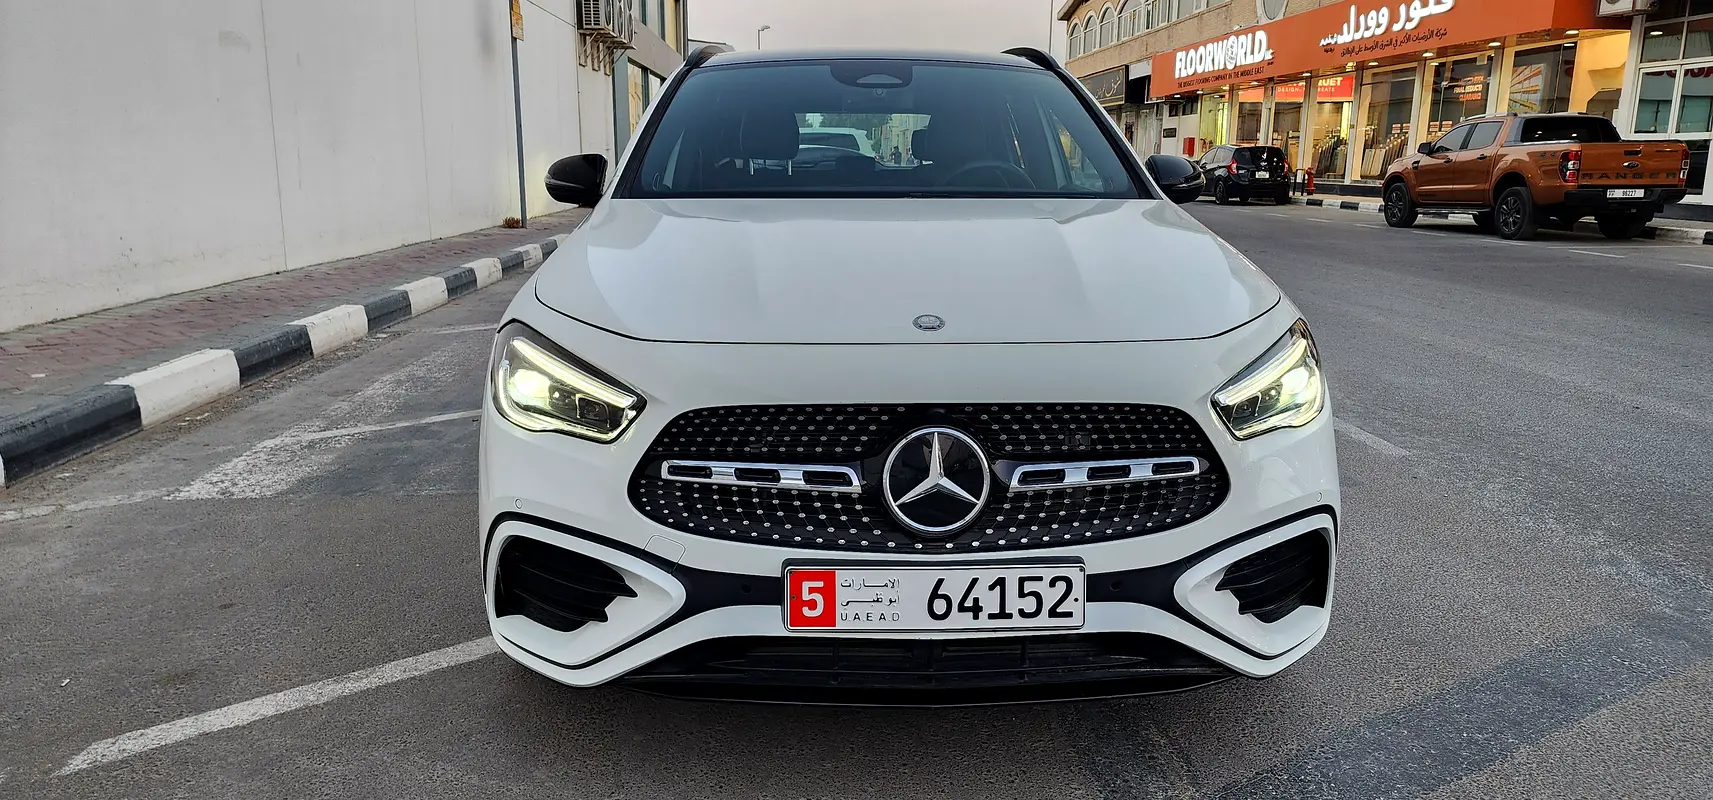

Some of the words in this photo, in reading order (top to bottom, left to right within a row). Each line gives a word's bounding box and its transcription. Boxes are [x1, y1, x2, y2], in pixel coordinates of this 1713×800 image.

[1337, 4, 1389, 44] وورلد
[1399, 32, 1411, 47] الأكبر
[1412, 28, 1434, 43] الأرضيات
[1435, 28, 1447, 40] شركة
[1364, 40, 1379, 52] الأوسط
[1379, 37, 1392, 50] الشرق
[1393, 36, 1398, 48] في
[1175, 30, 1267, 79] FLOORWORLD
[1355, 45, 1363, 55] على
[1211, 74, 1228, 83] COMPANY
[1228, 72, 1232, 80] IN
[1240, 69, 1253, 77] MIDDLE
[1254, 66, 1264, 75] EAST
[1581, 172, 1677, 180] RANGER
[802, 581, 825, 617] 5
[840, 592, 883, 611] ظبي
[927, 576, 1074, 620] 64152
